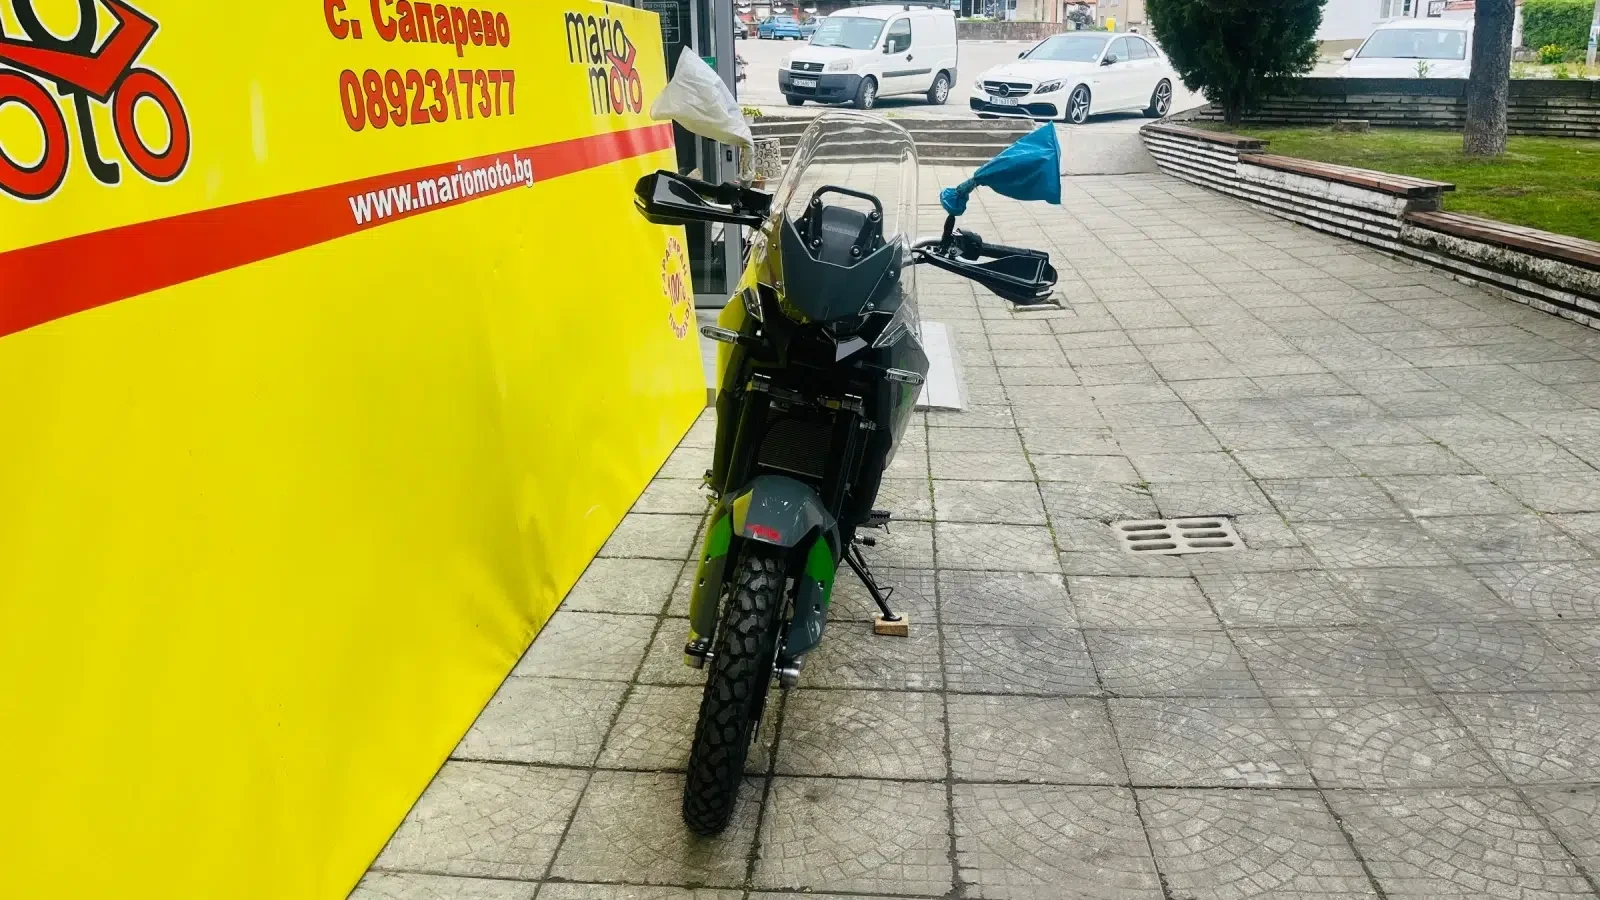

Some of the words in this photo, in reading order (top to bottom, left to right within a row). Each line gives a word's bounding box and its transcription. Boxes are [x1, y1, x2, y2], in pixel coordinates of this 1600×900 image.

[370, 0, 510, 57] Сапарево
[564, 4, 626, 64] mario
[339, 69, 515, 132] 0892317377
[588, 66, 643, 116] moto
[348, 154, 534, 226] www.mariomoto.bg
